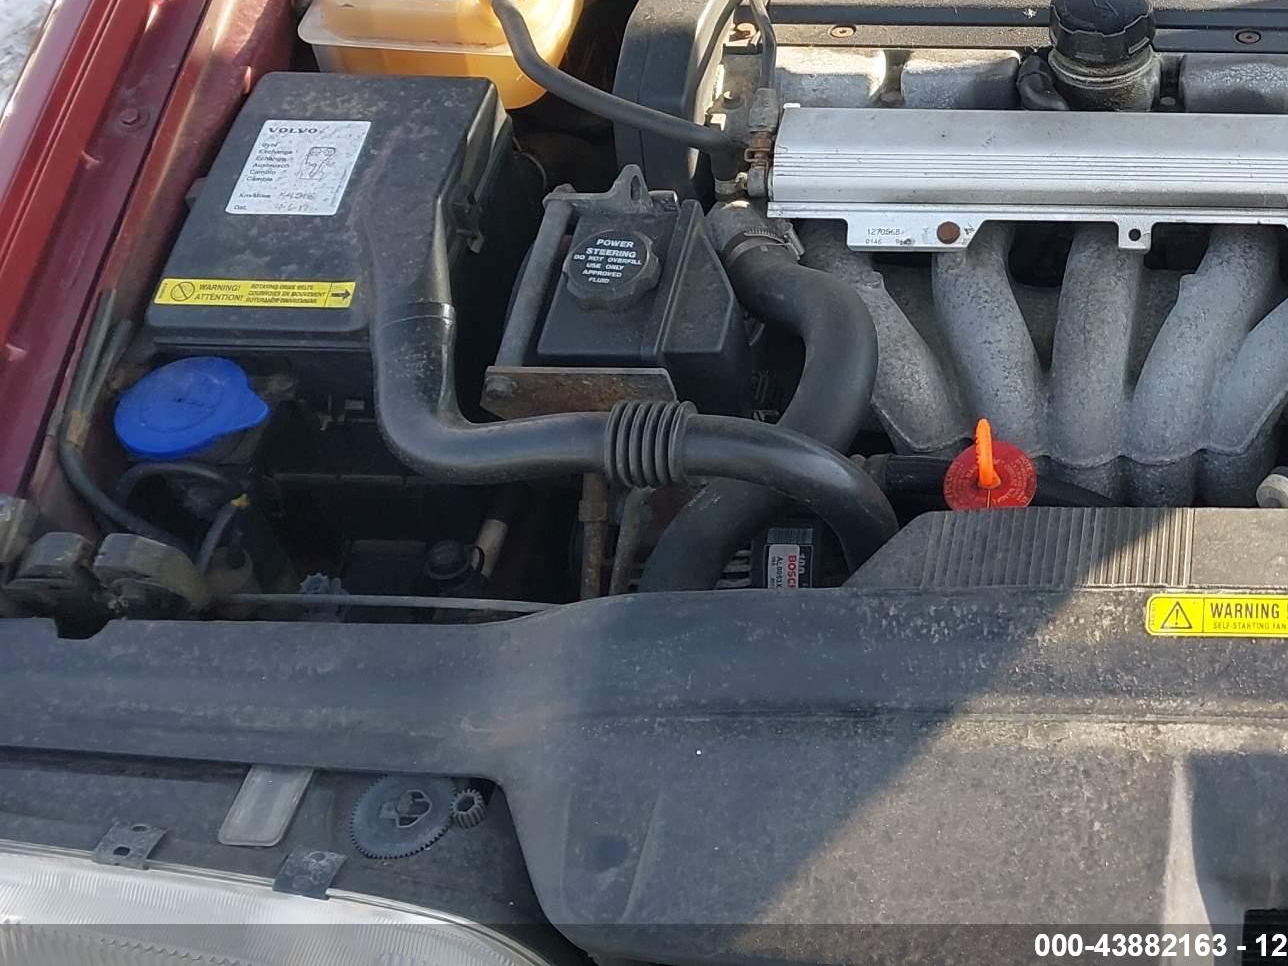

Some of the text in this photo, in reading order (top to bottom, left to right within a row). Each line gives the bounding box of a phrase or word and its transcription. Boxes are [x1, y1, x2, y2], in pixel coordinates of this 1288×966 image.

[596, 238, 634, 248] POWER
[586, 247, 636, 258] STEERING
[607, 257, 642, 265] OVERFILL
[582, 269, 622, 277] APPROVED
[199, 283, 240, 292] WARNING!
[194, 293, 244, 301] ATTENTION!
[1210, 602, 1280, 619] WARNING
[1213, 621, 1287, 630] SELF-STARTING FAN
